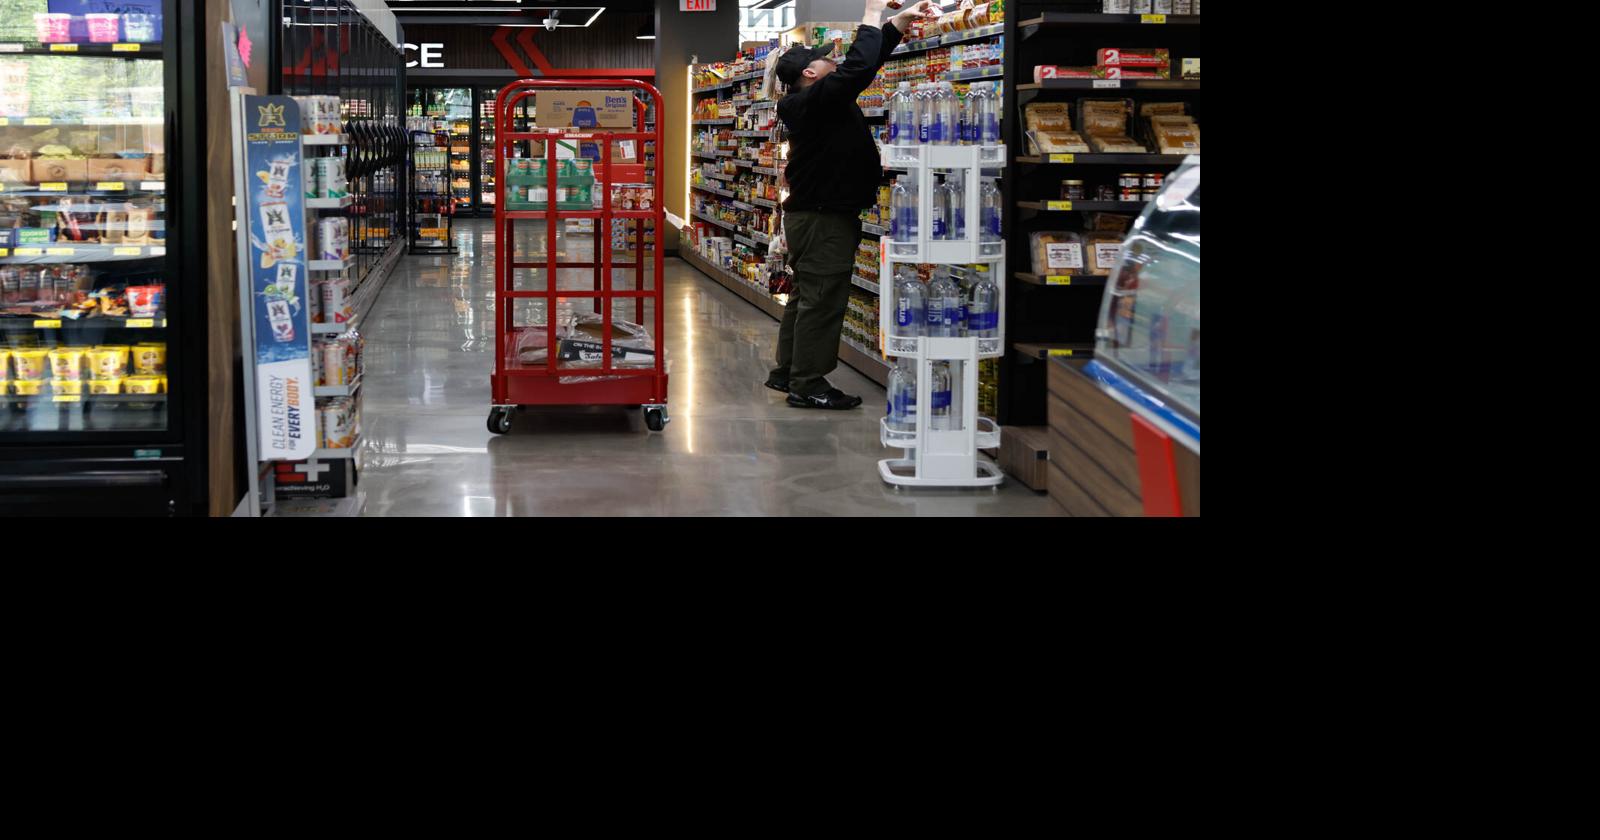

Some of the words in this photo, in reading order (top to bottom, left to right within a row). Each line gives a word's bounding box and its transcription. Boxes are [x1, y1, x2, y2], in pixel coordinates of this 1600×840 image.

[686, 0, 709, 10] EXIT
[1104, 50, 1119, 65] 2
[605, 95, 627, 103] Ben's
[920, 113, 928, 139] smart
[270, 375, 284, 415] ENERGY
[272, 417, 285, 450] CLEAN
